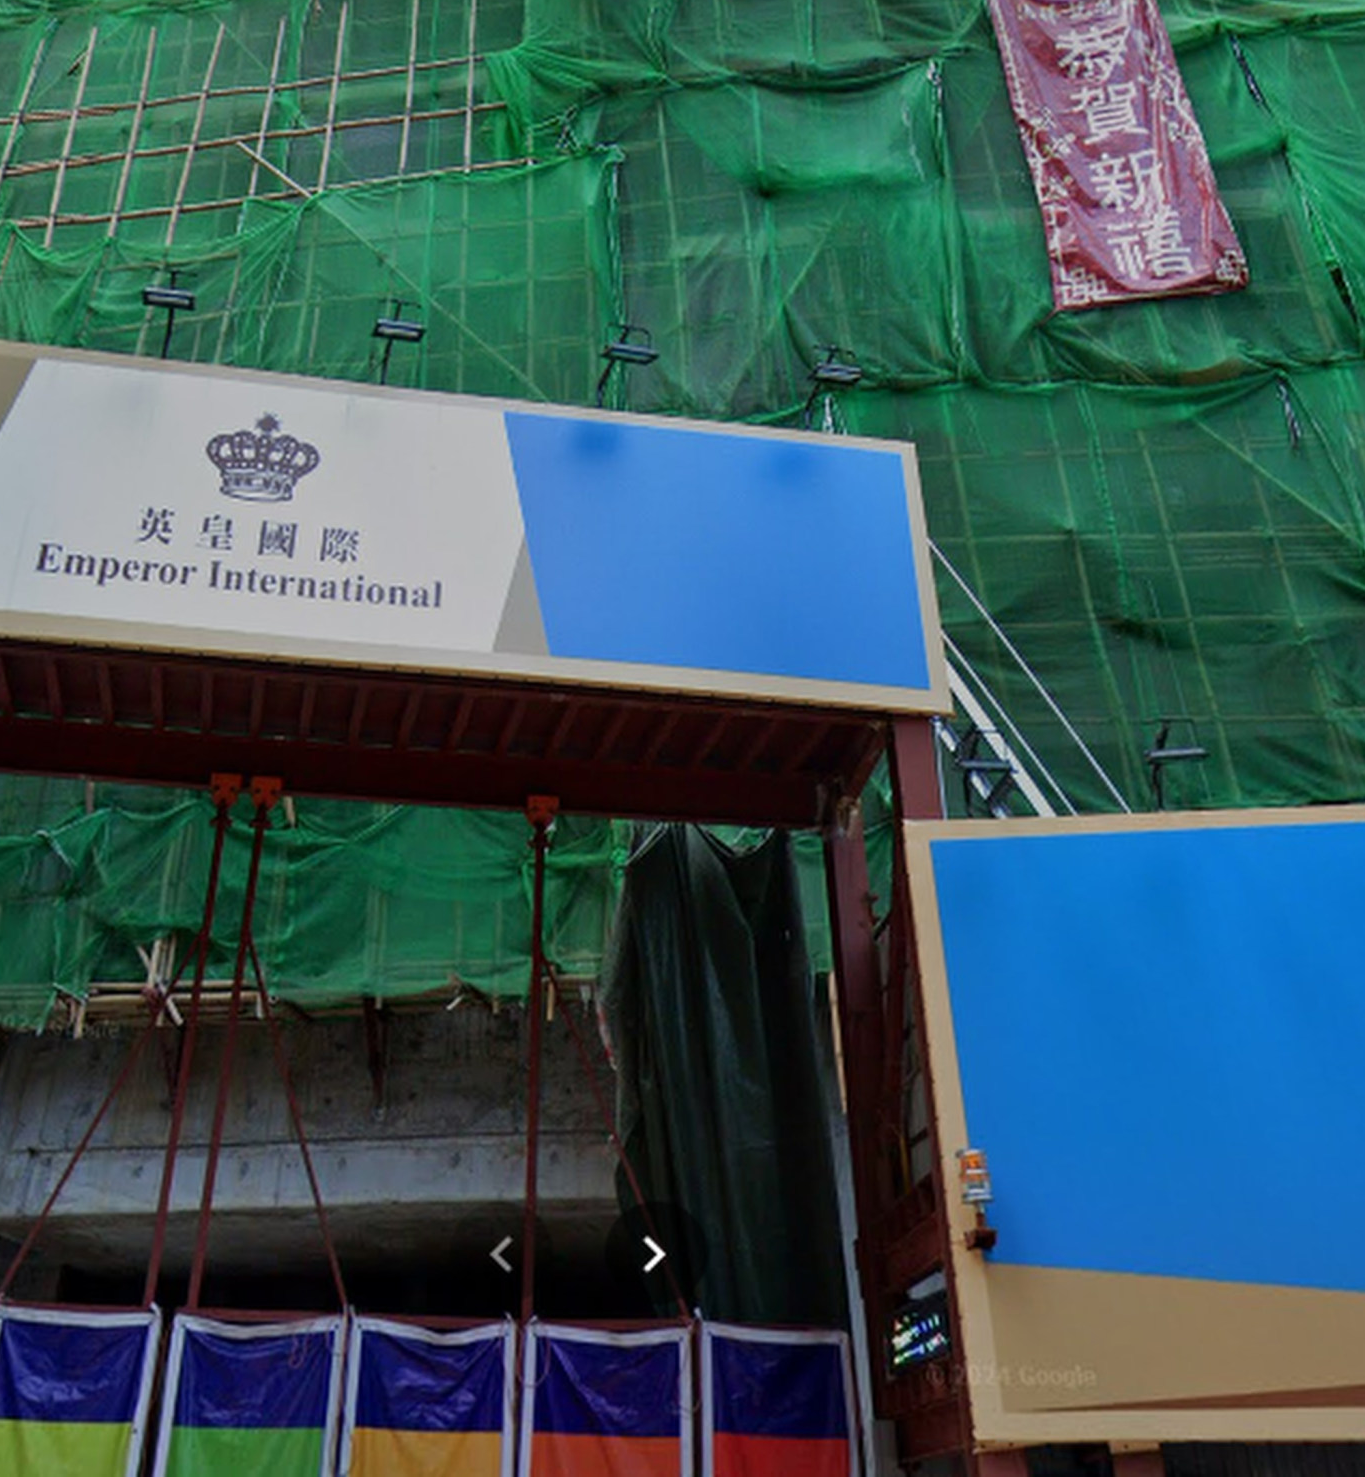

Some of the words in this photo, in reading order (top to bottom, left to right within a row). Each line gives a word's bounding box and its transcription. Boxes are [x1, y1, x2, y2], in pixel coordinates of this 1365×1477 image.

[136, 506, 361, 564] 英皇國際
[35, 542, 198, 587] Emperor
[207, 558, 444, 609] International
